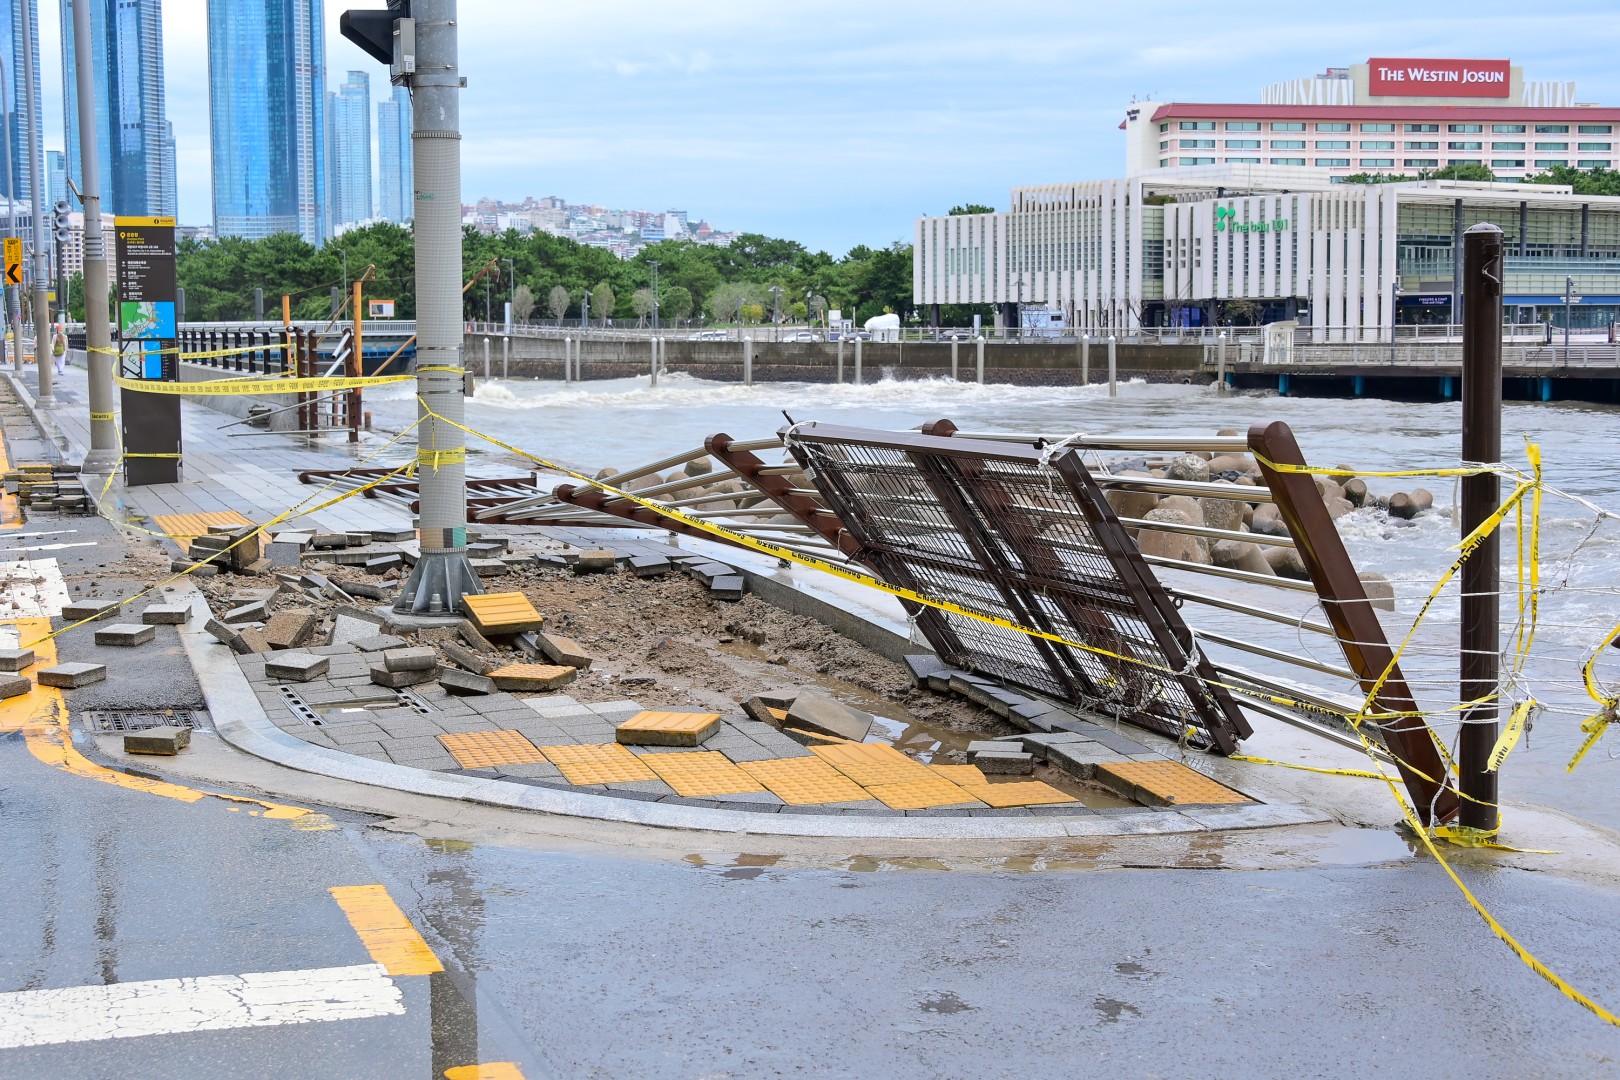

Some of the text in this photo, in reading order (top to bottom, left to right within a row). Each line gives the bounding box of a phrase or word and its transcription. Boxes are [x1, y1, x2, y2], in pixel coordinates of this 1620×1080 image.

[1232, 219, 1288, 233] The bay 101
